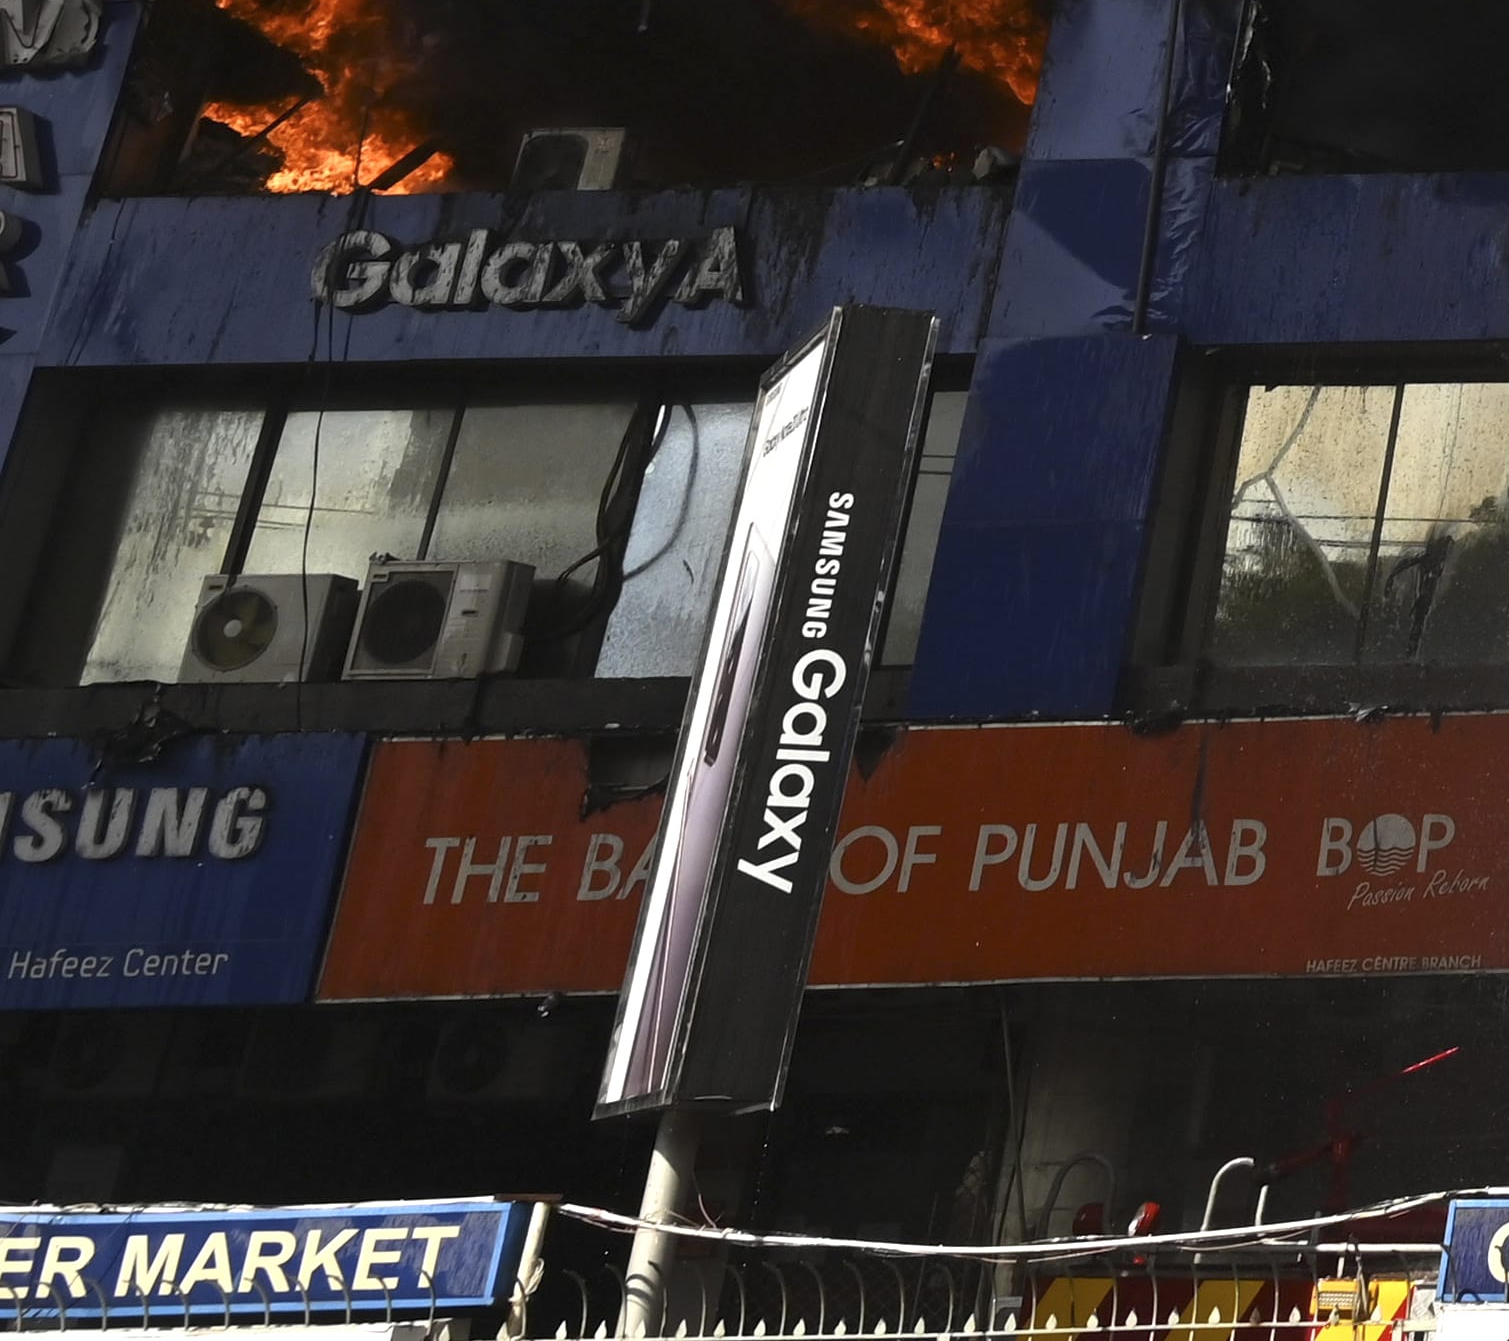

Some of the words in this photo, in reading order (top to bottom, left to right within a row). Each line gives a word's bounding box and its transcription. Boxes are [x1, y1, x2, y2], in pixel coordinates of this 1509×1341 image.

[803, 489, 854, 641] SAMSUNG
[737, 646, 847, 895] Galaxy
[423, 834, 553, 906] THE
[577, 832, 656, 903] BA
[829, 823, 944, 895] OF
[968, 816, 1269, 893] PUNJAB
[1346, 881, 1416, 912] Passion
[1421, 871, 1491, 902] Reborn
[7, 949, 114, 982] Hafeez
[122, 948, 230, 980] Center
[1305, 959, 1359, 974] HAFEEZ
[1362, 957, 1420, 972] CENTRE
[1421, 954, 1483, 970] BRANCH
[115, 1224, 462, 1296] MARKET
